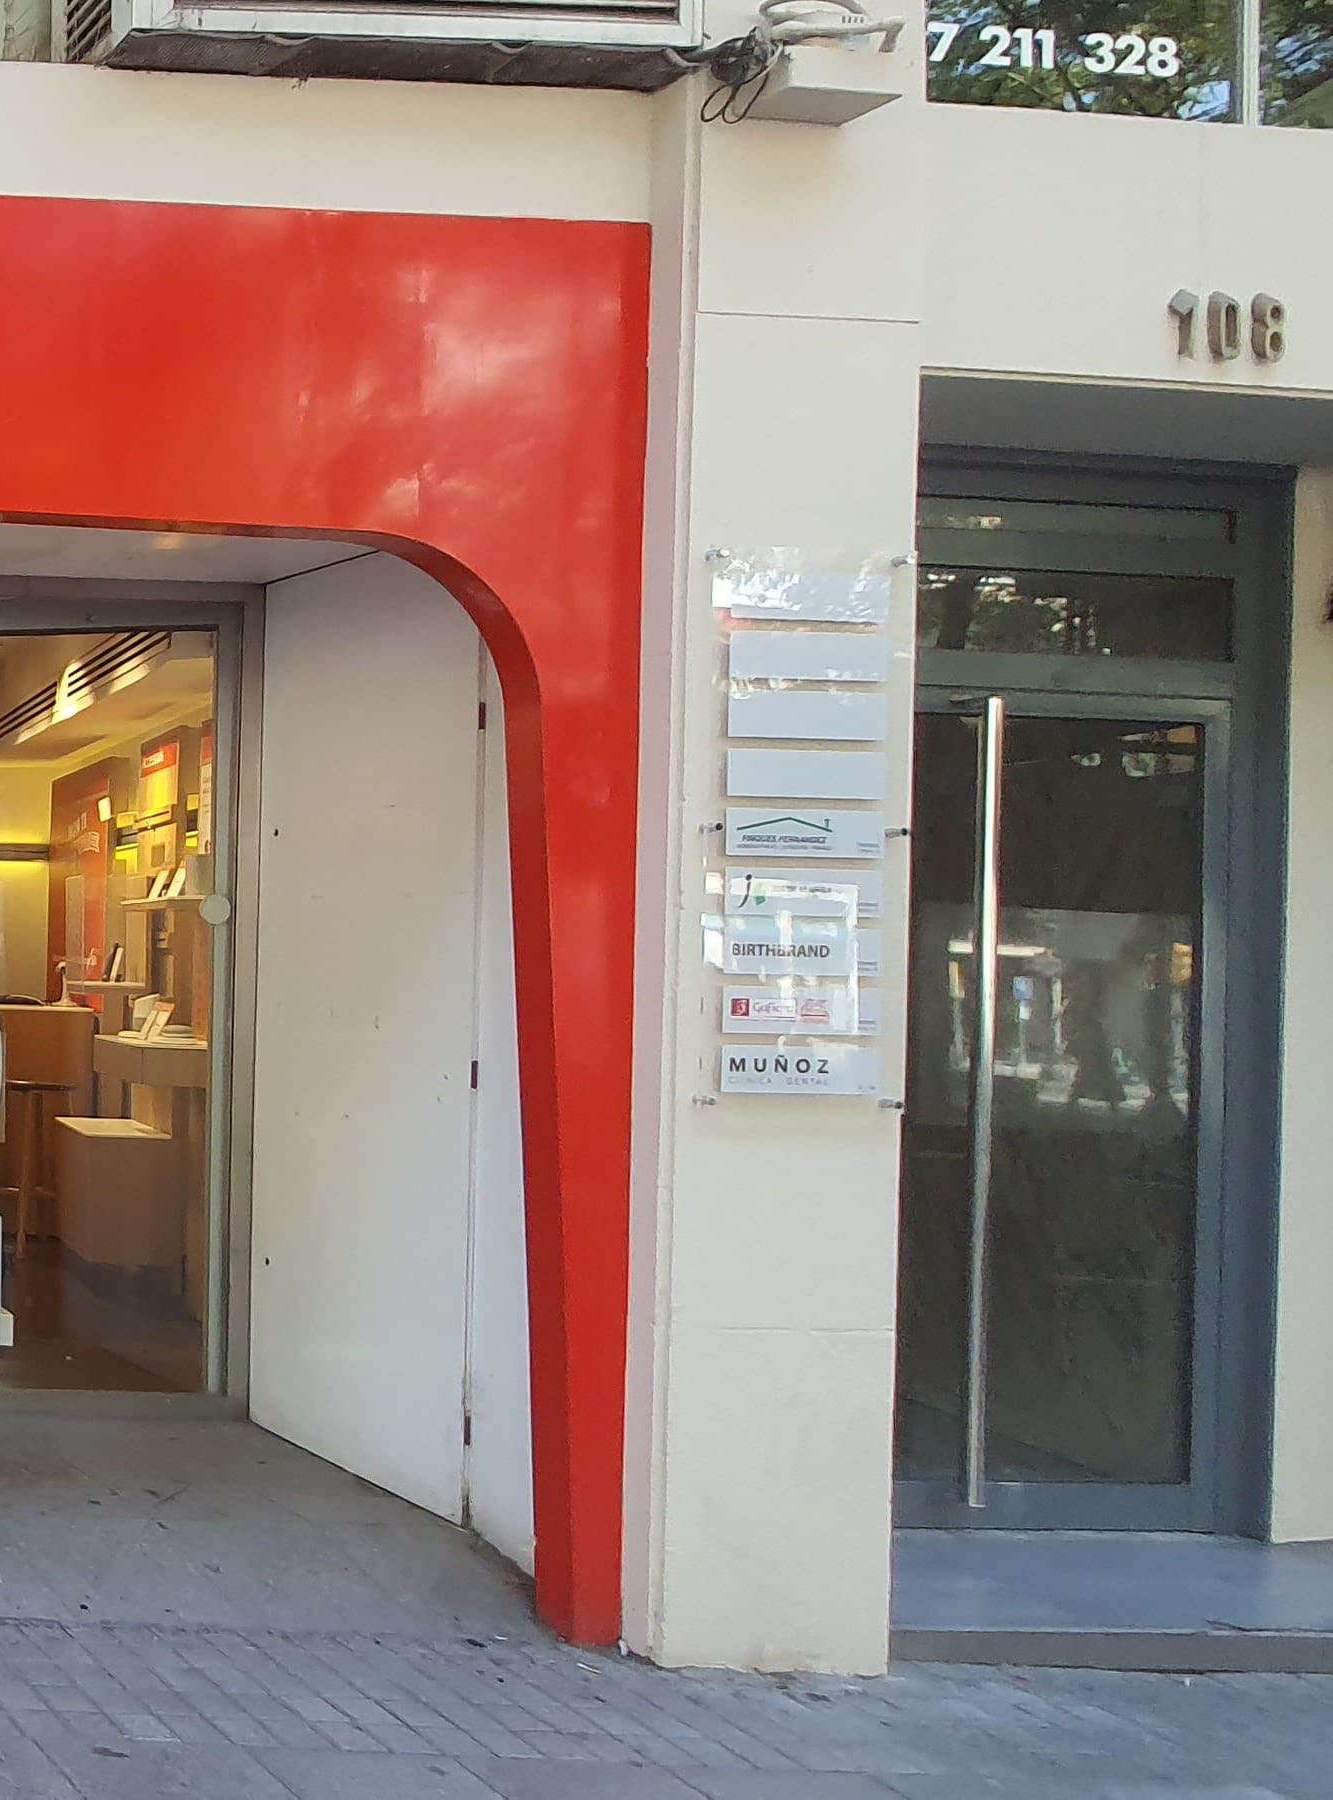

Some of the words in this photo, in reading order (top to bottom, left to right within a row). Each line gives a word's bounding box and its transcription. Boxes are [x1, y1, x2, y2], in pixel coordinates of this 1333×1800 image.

[979, 26, 1056, 70] 211
[1084, 33, 1180, 78] 328
[1167, 288, 1286, 364] 108
[732, 943, 831, 959] BIRTHBRAND
[729, 1054, 830, 1074] MUÑOZ
